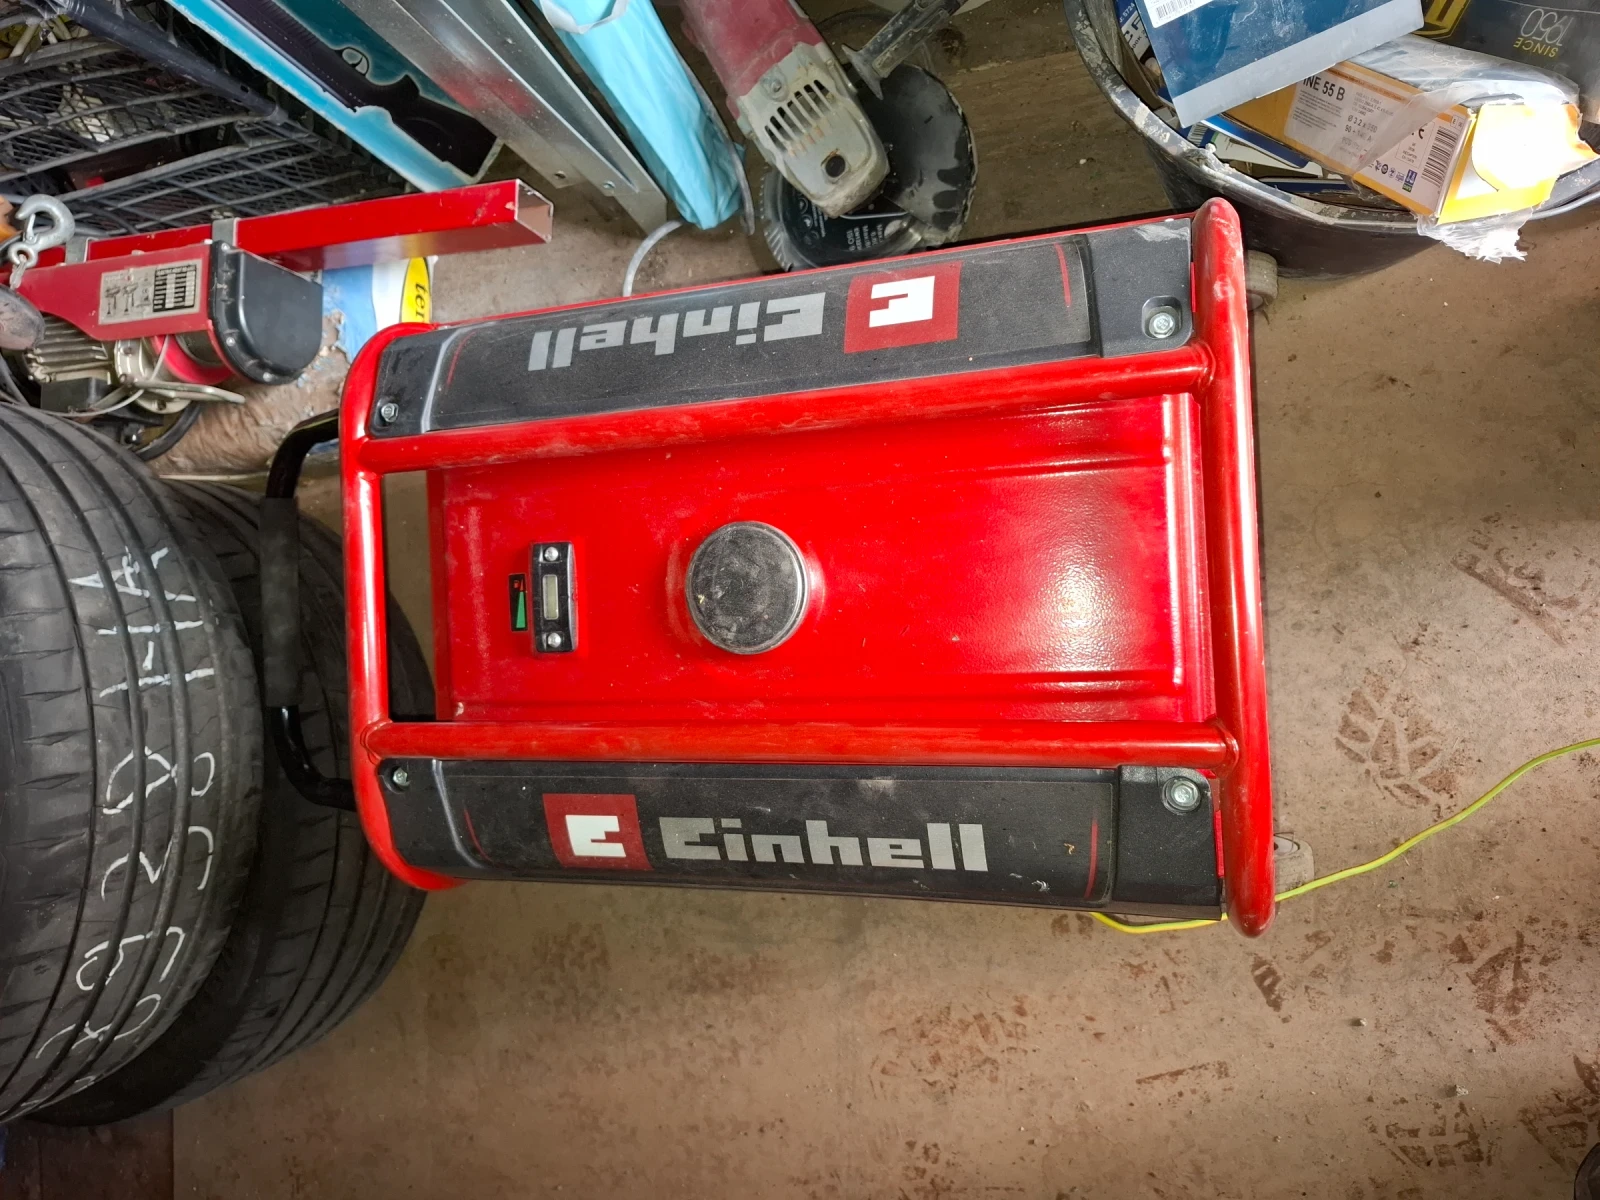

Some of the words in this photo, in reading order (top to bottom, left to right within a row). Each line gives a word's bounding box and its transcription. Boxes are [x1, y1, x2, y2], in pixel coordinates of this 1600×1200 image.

[1520, 8, 1574, 47] 1950
[1513, 37, 1559, 58] SINCE
[1322, 80, 1336, 97] 55
[1336, 86, 1346, 101] B
[528, 292, 826, 371] Einhell
[658, 816, 989, 872] Einhell
